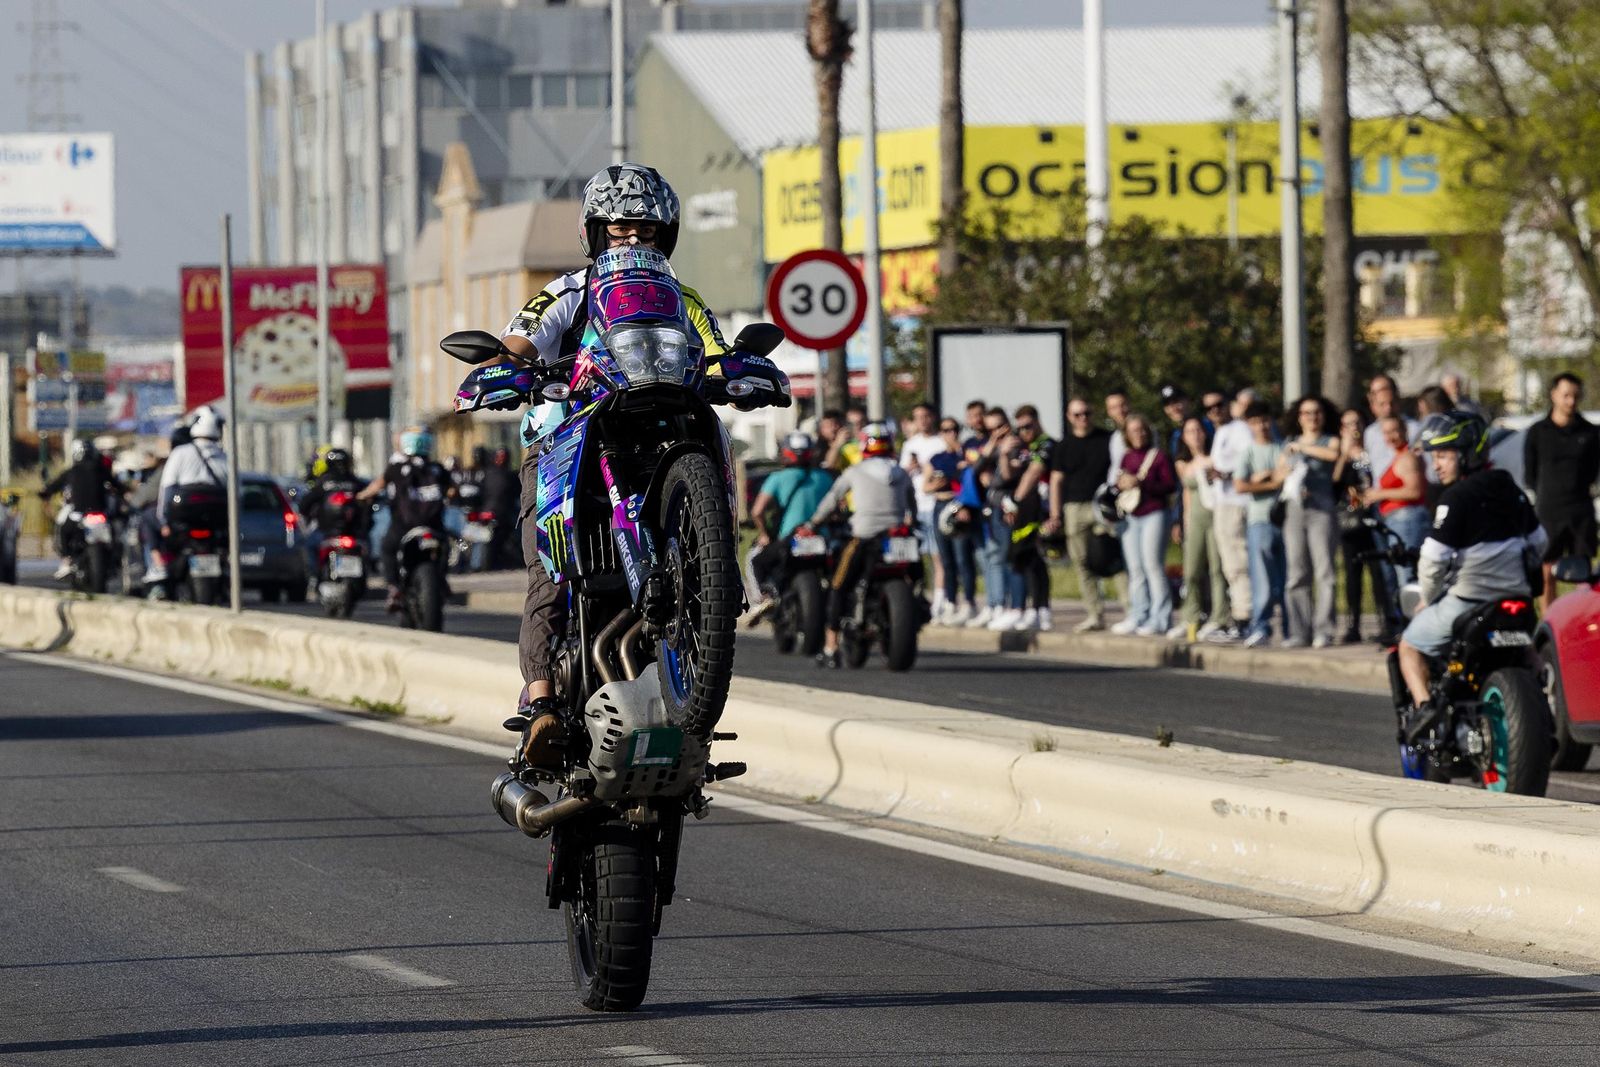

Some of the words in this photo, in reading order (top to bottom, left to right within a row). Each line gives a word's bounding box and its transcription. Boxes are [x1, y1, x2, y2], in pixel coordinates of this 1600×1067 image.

[597, 252, 620, 267] ONLY
[790, 283, 847, 316] 30
[484, 365, 503, 374] NO
[742, 358, 775, 369] PANIC
[476, 369, 512, 381] PANIC
[617, 532, 640, 590] BIKELIFE
